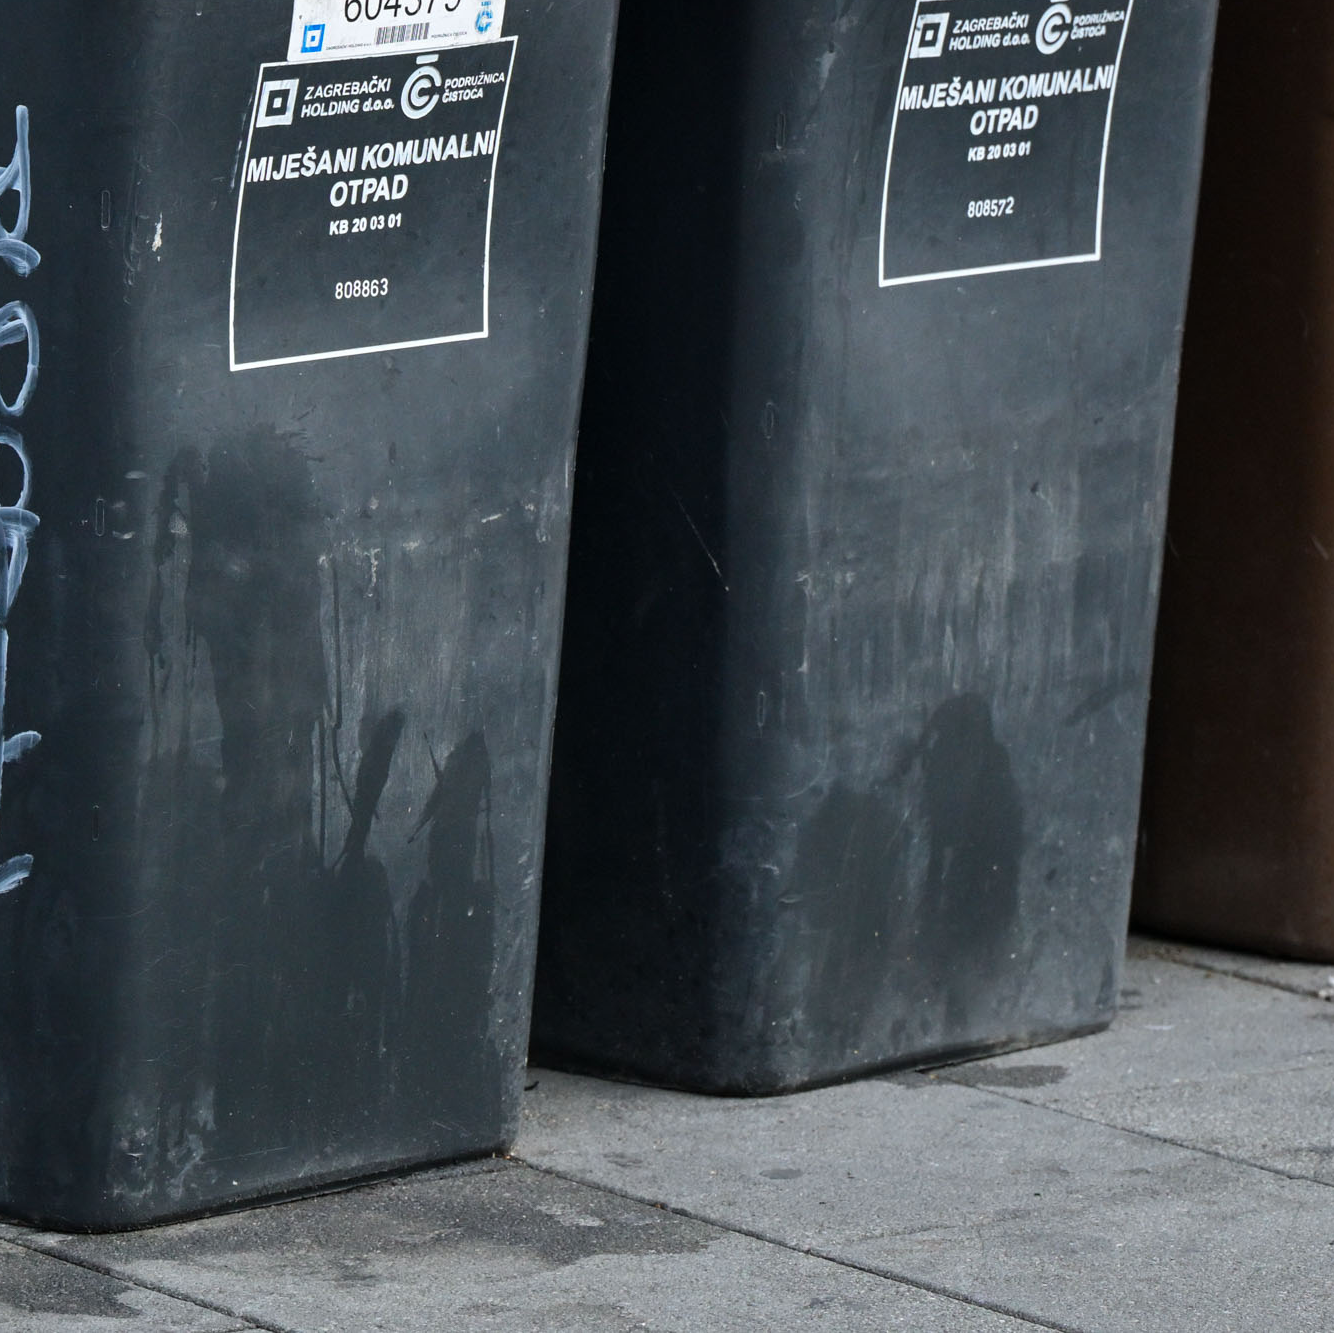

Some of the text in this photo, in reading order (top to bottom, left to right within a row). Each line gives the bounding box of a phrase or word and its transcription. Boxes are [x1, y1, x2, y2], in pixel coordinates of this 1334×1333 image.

[953, 11, 1029, 33] ZAGREBAČKI
[949, 32, 1001, 51] HOLDING
[304, 75, 392, 101] ZAGREBAČKI
[444, 71, 506, 91] PODRUŽNICA
[899, 64, 1115, 111] MIJEŠANI KOMUNALNI
[442, 85, 484, 104] ČISTOĆA
[301, 98, 395, 119] HOLDING d.o.o.
[970, 104, 1039, 136] OTPAD
[247, 130, 496, 183] MIJEŠANI KOMUNALNI
[967, 141, 1032, 162] KB 20 03 01
[330, 174, 409, 208] OTPAD
[967, 196, 1015, 218] 808572
[329, 212, 403, 236] KB 20 03 01
[335, 277, 389, 300] 808863
